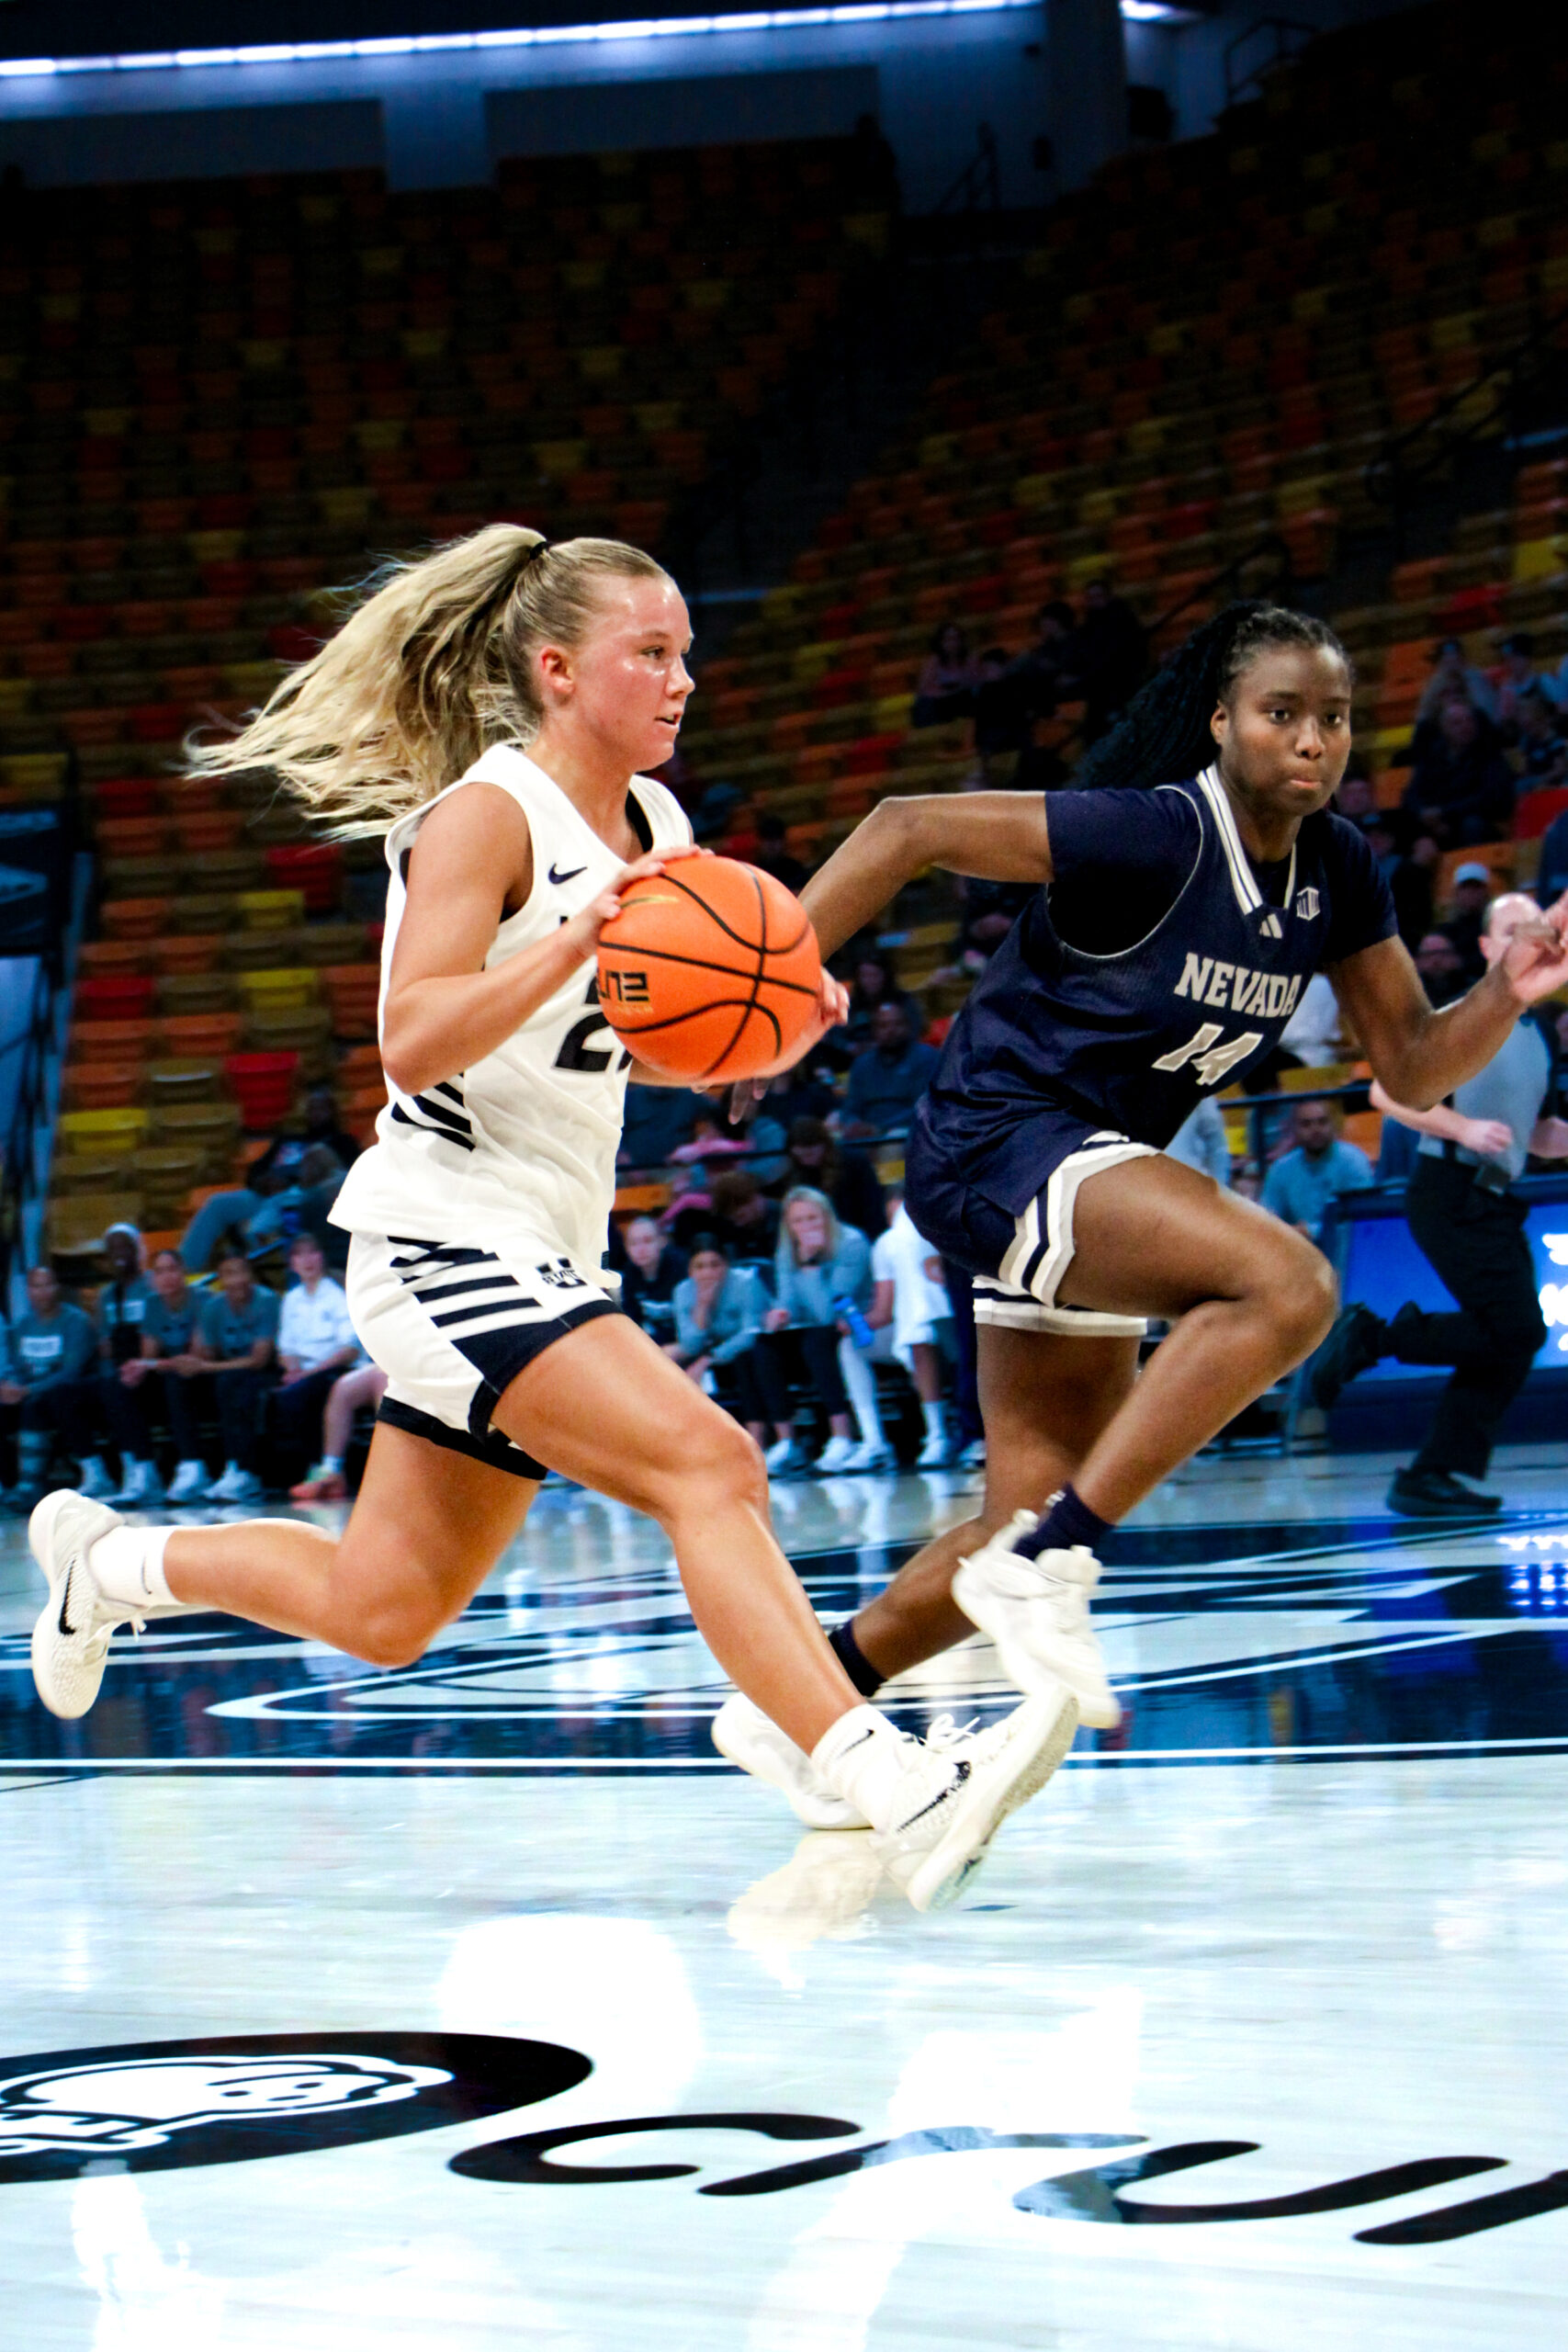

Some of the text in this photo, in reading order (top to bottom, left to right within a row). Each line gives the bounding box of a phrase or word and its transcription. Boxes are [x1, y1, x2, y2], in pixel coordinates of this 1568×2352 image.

[1173, 952, 1303, 1018] NEVADA
[552, 972, 633, 1073] 2
[1151, 1022, 1264, 1087] 14
